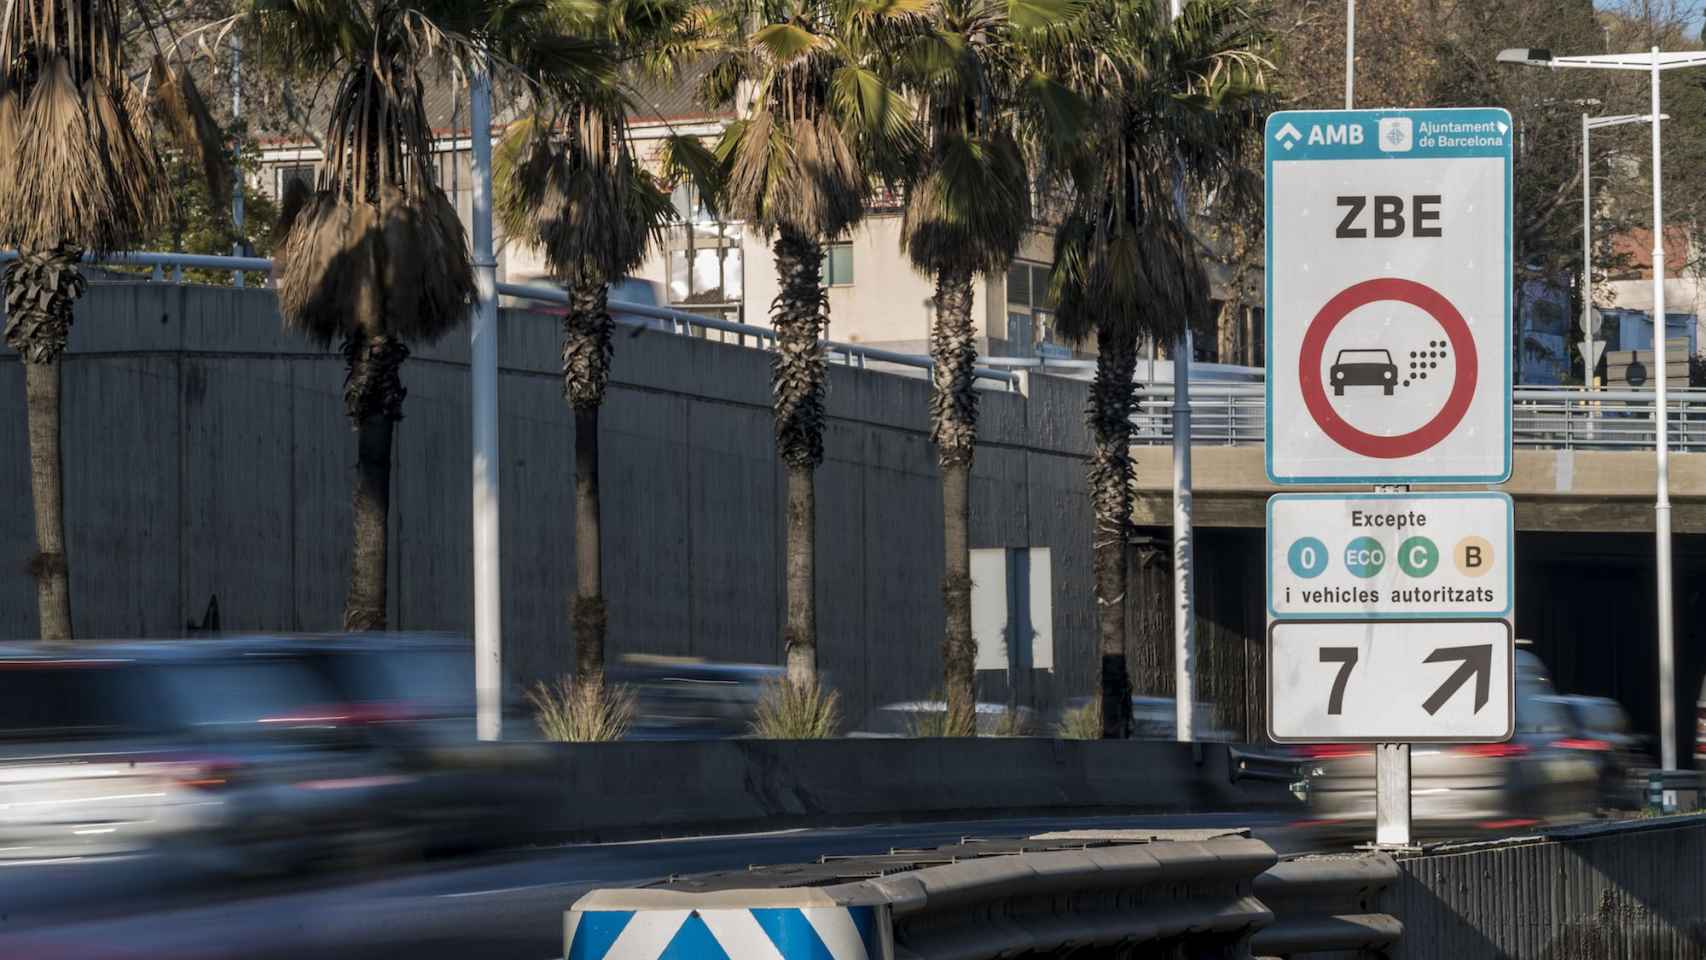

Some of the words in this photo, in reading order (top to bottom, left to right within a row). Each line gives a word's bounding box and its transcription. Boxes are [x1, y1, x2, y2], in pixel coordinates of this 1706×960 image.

[1307, 124, 1365, 145] AMB
[1419, 121, 1495, 136] Ajuntament
[1419, 136, 1435, 148] de
[1438, 135, 1503, 148] Barcelona
[1335, 195, 1443, 239] ZBE
[1352, 510, 1427, 530] Excepte
[1346, 549, 1384, 566] ECO
[1408, 546, 1428, 569] C
[1465, 546, 1482, 568] B
[1285, 587, 1291, 603] i
[1302, 586, 1379, 603] vehicles
[1391, 586, 1494, 603] autoritzats
[1319, 646, 1359, 715] 7
